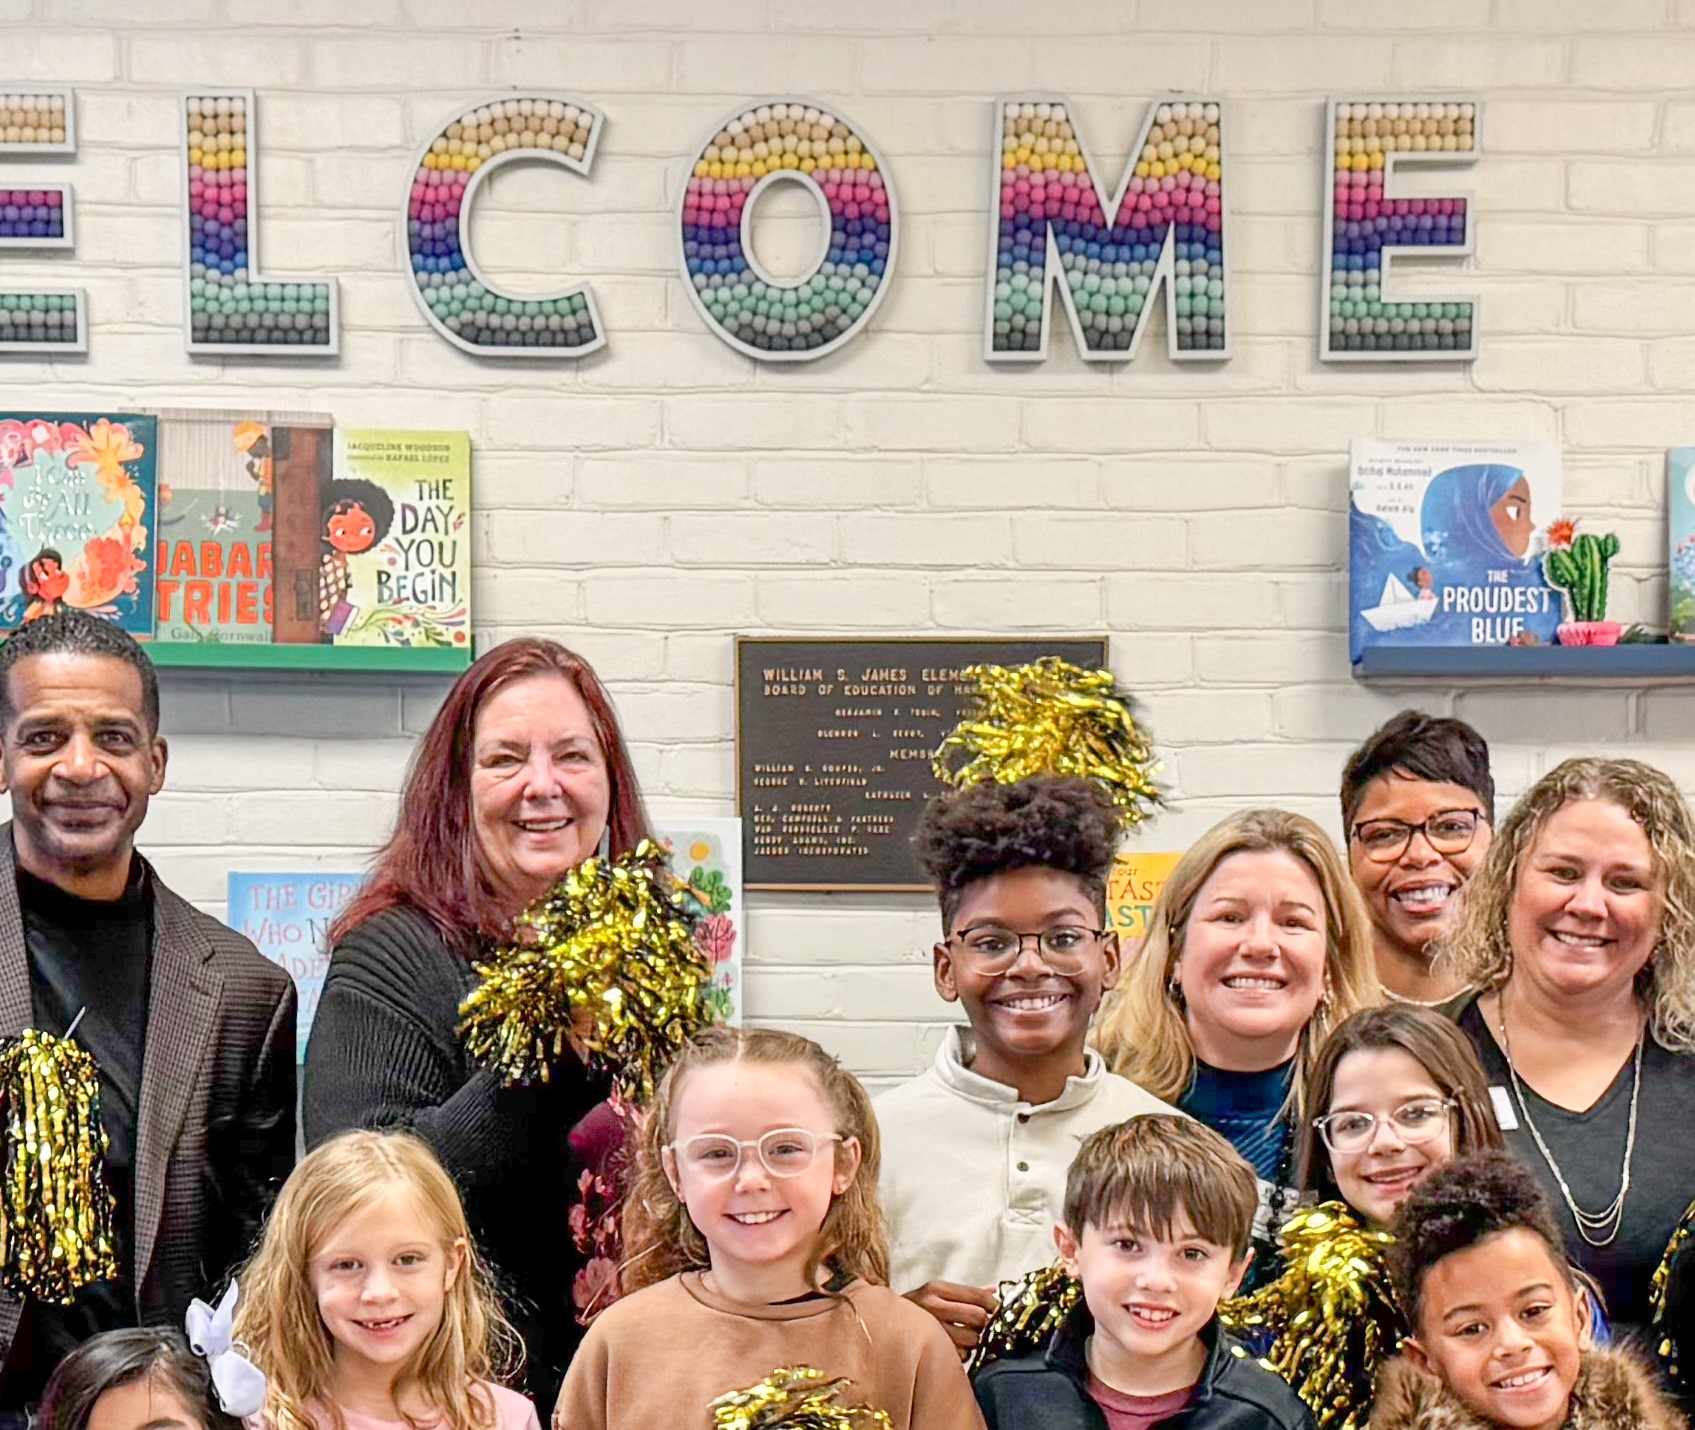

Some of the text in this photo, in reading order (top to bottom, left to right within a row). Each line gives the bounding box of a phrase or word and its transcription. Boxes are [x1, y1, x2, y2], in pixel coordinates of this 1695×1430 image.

[415, 479, 454, 501] THE
[401, 503, 455, 536] DAY
[394, 536, 457, 571] YOU
[1487, 569, 1508, 583] THE
[1443, 586, 1552, 613] PROUDEST
[763, 669, 823, 681] WILLIAM
[861, 669, 907, 681] JAMES
[763, 685, 806, 696] BOARD
[844, 685, 916, 696] EDUCATION
[247, 884, 299, 912] THE
[243, 918, 302, 945] WHO
